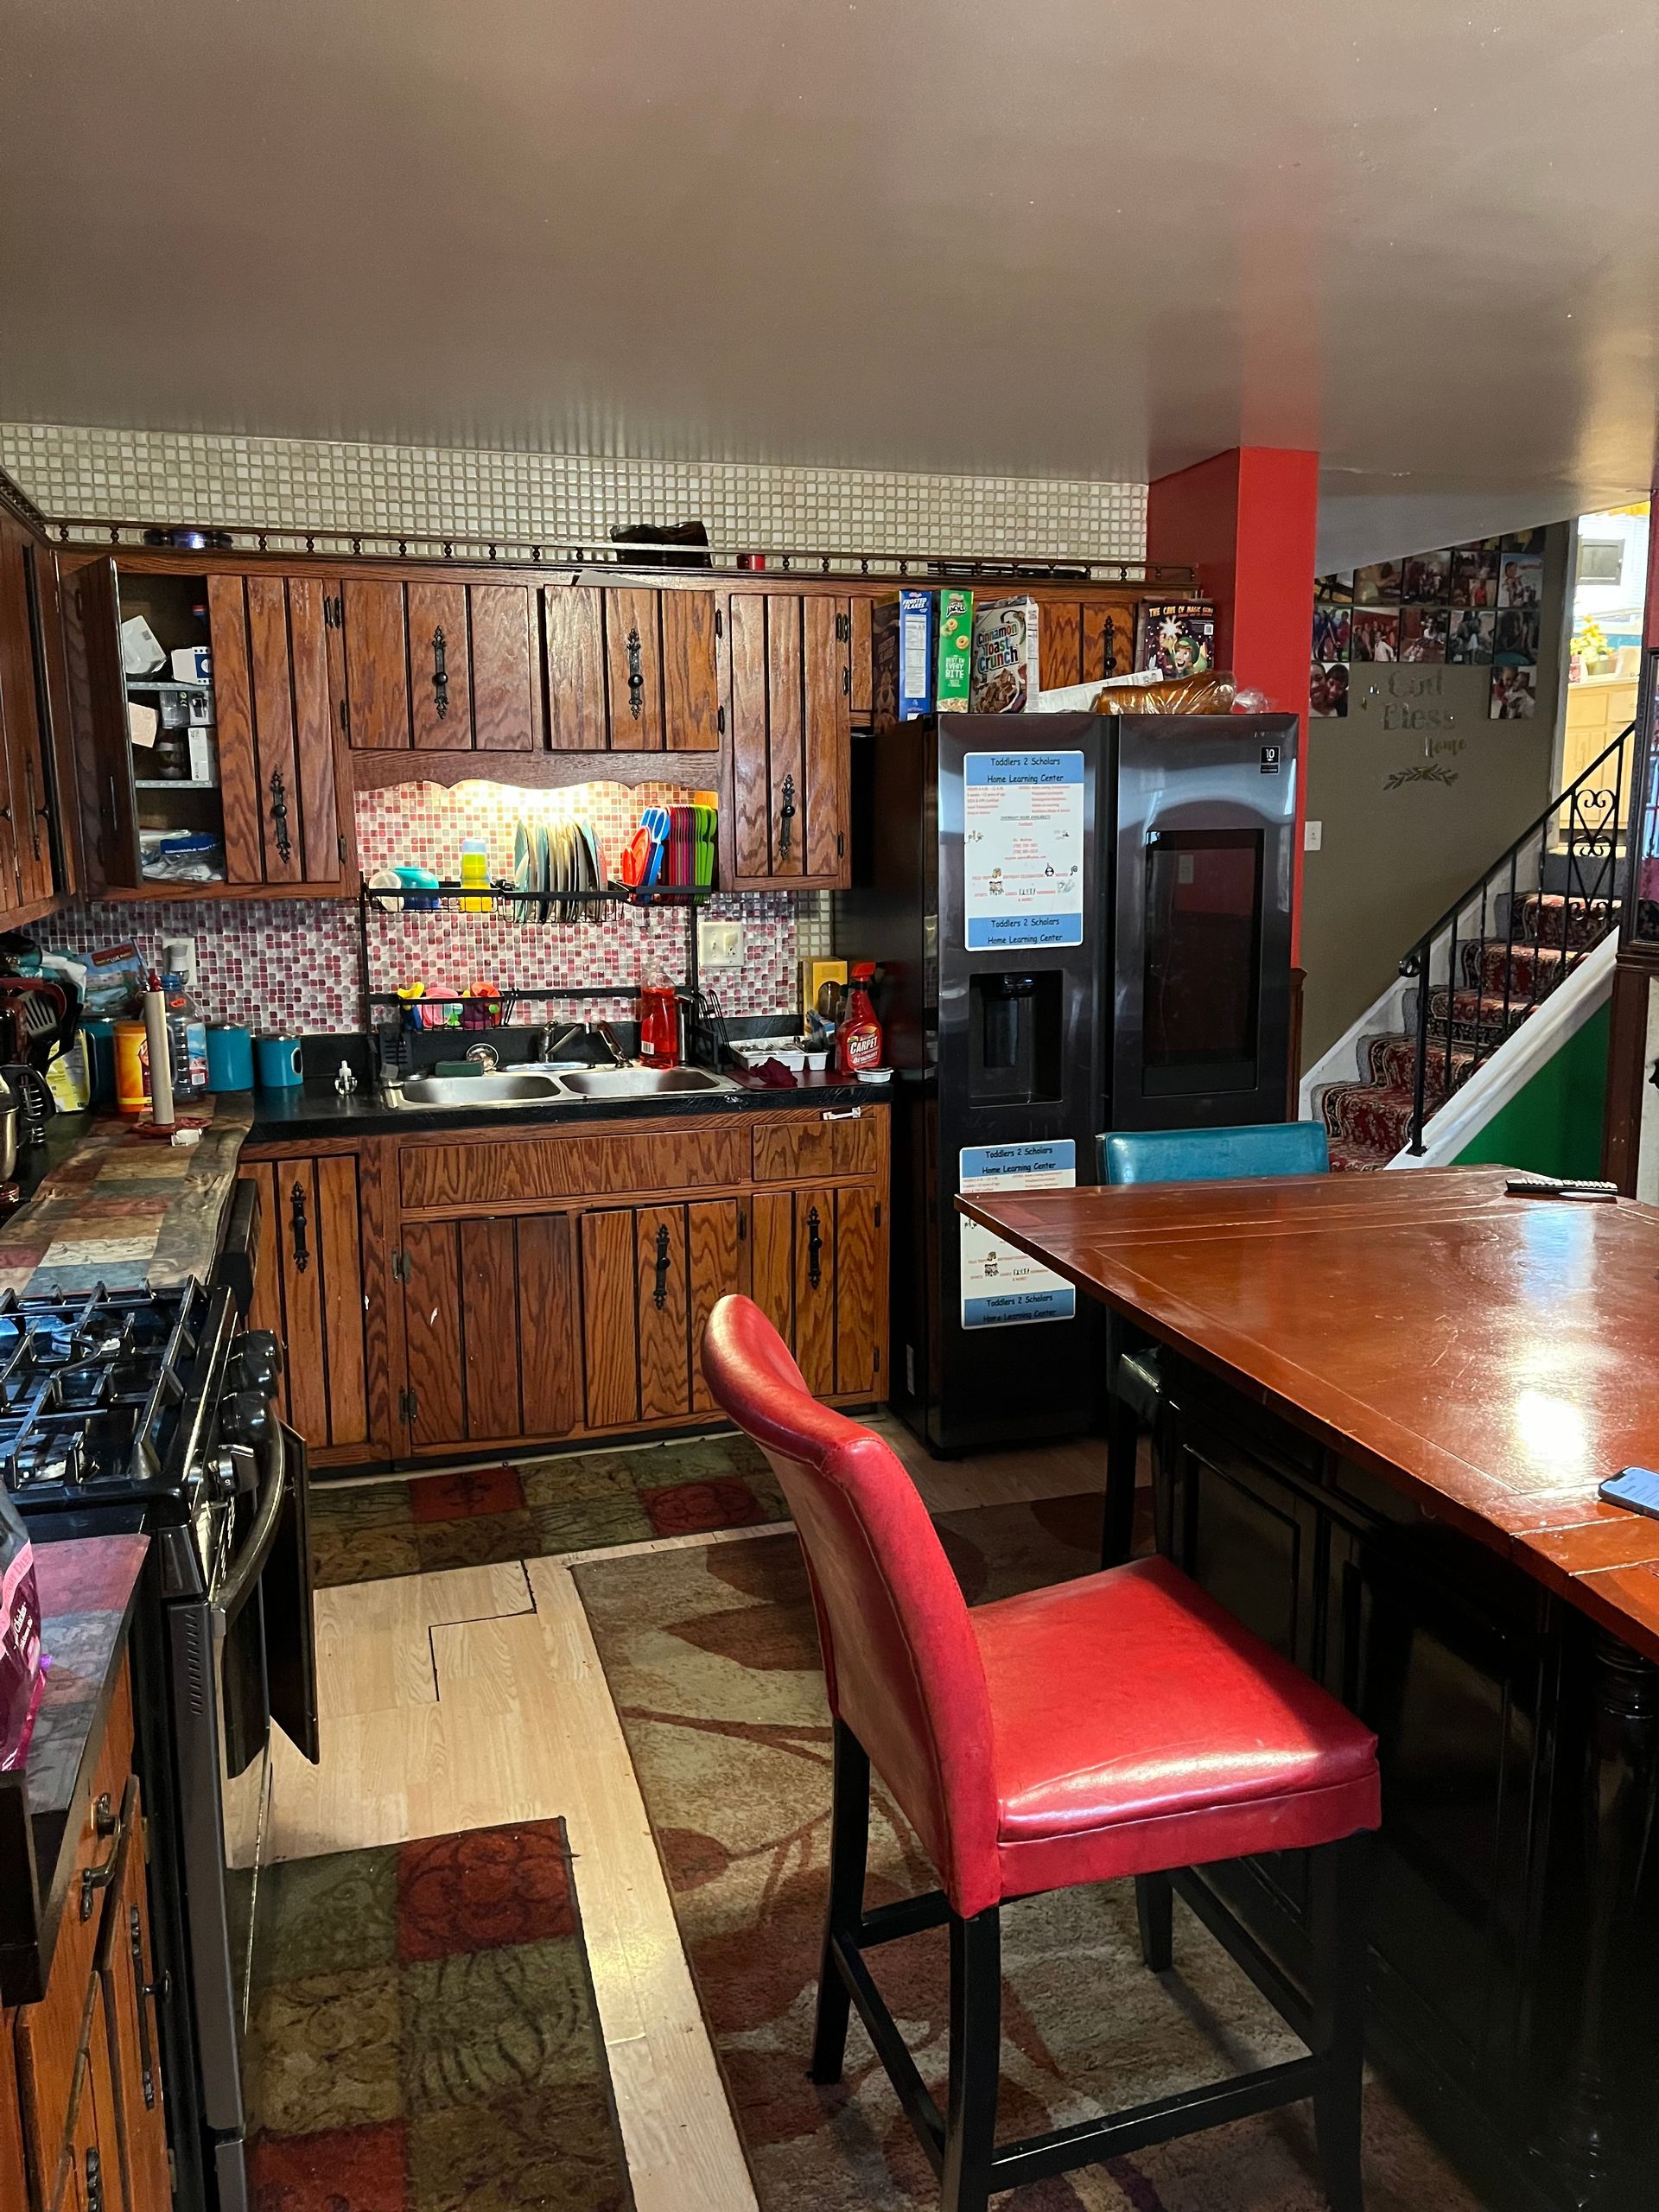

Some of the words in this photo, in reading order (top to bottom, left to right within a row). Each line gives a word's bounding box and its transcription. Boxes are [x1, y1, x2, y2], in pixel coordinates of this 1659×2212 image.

[977, 622, 1018, 646] Cinnamon
[983, 636, 1010, 656] Toast
[978, 646, 1019, 672] Crunch
[945, 669, 964, 678] BITE
[1266, 748, 1274, 758] 10
[990, 757, 1021, 766] Toddlers
[1023, 757, 1028, 766] 2
[1032, 757, 1061, 766] Scholars
[1009, 774, 1039, 785] Learning
[991, 919, 1021, 928] Toddlers
[1031, 918, 1059, 926] Scholars
[1009, 935, 1038, 944] Learning
[850, 1037, 878, 1054] CARPET
[985, 1149, 1014, 1158] Toddlers
[1024, 1147, 1052, 1155] Scholars
[1003, 1164, 1032, 1173] Learning
[1033, 1161, 1056, 1170] Center
[986, 1299, 1015, 1307] Toddlers
[1018, 1296, 1022, 1305] 2
[1025, 1294, 1052, 1303] Scholars
[983, 1314, 1001, 1323] Home
[1004, 1312, 1032, 1322] Learning
[1033, 1308, 1058, 1318] Center
